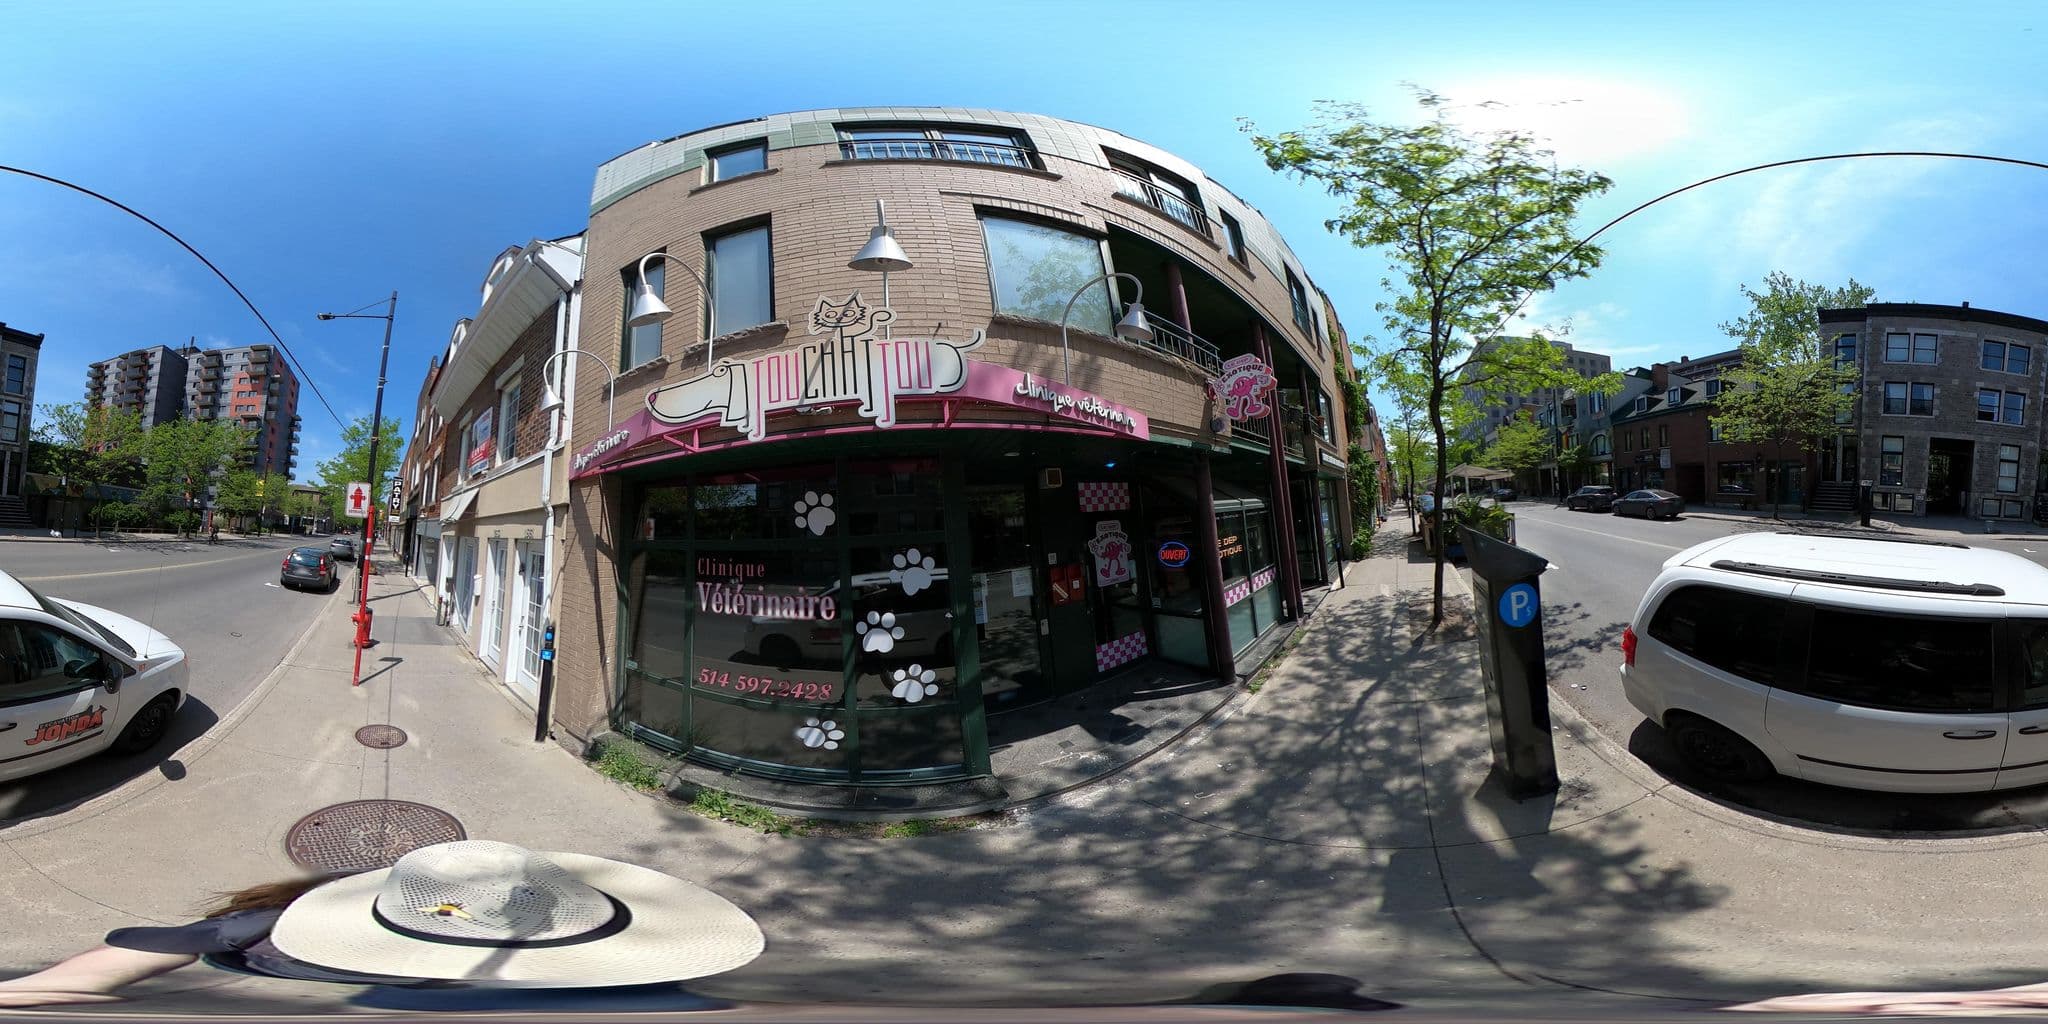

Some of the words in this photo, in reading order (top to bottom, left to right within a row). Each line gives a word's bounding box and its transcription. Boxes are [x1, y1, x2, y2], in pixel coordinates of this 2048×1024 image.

[1221, 364, 1263, 382] EXOTIQUE
[1016, 372, 1074, 412] clinique
[1077, 396, 1136, 427] vétérinaire
[393, 481, 401, 510] PATRY
[1216, 544, 1243, 559] OTIQUE
[1223, 535, 1237, 546] DEP
[1160, 549, 1187, 560] OUVERT
[698, 558, 765, 582] Clinique
[696, 581, 835, 620] Vétérinaire
[699, 668, 730, 687] 514
[735, 675, 832, 700] 597.2428
[24, 706, 105, 746] JONDA
